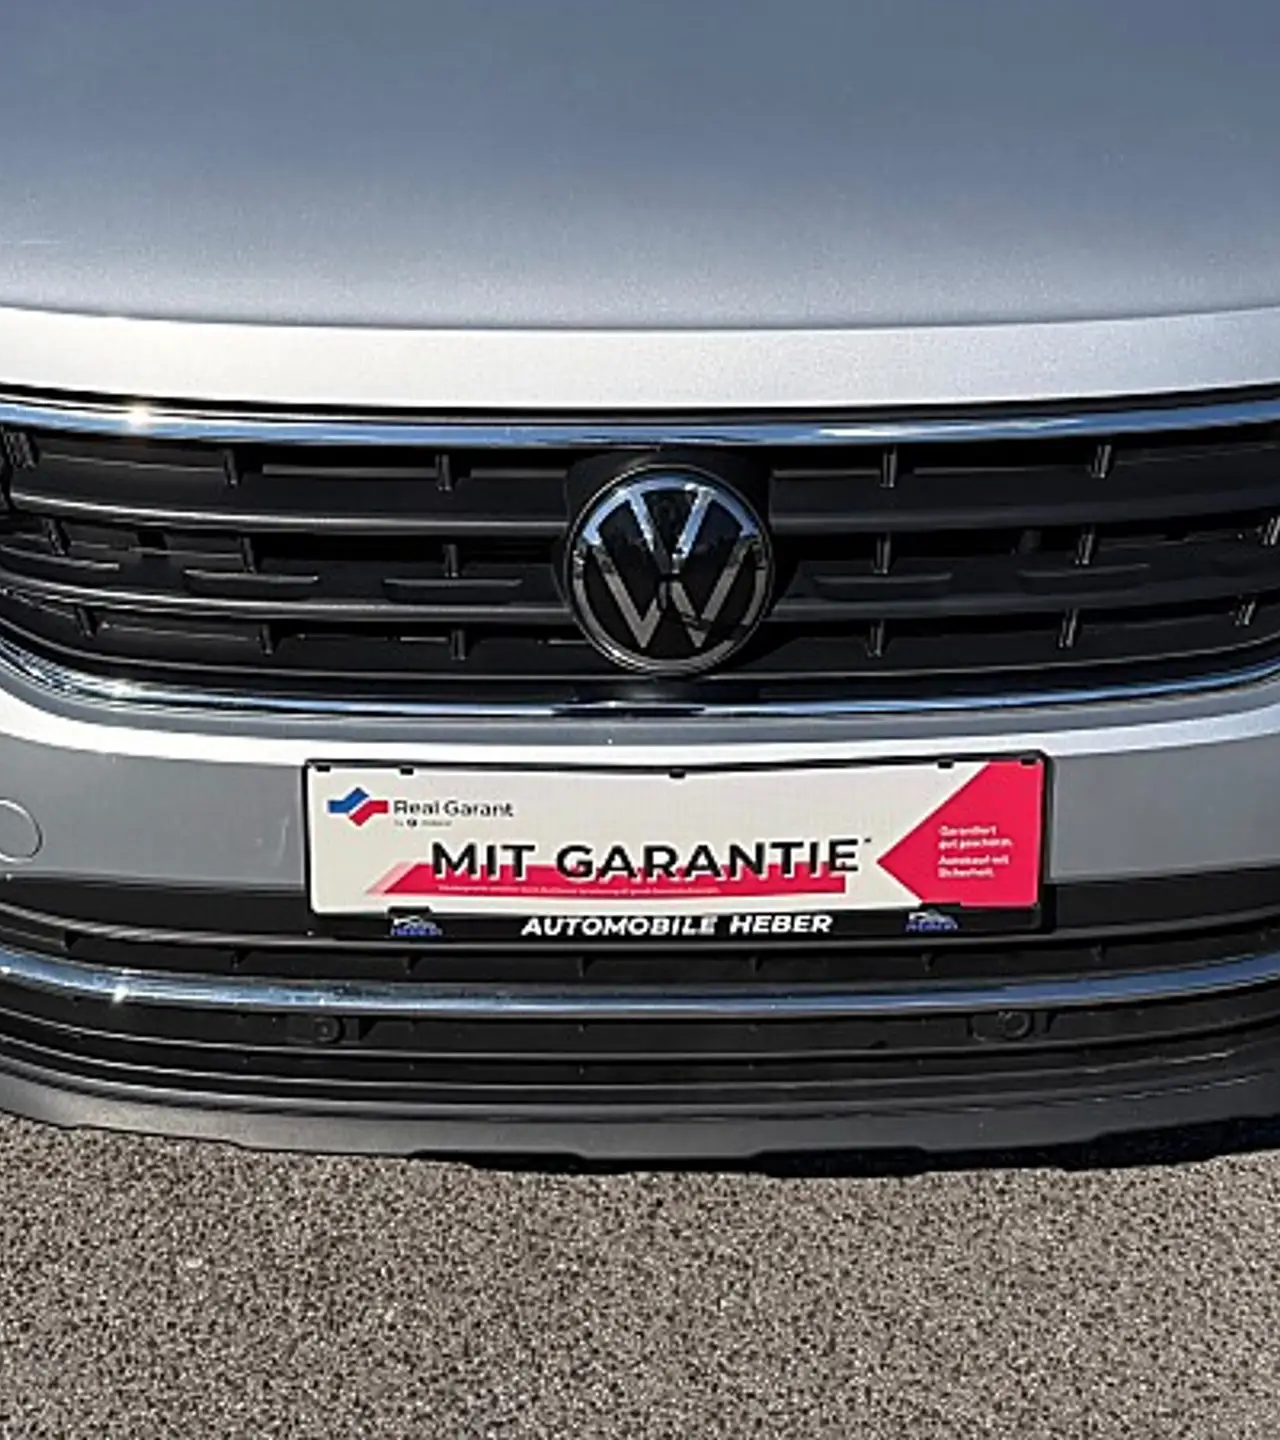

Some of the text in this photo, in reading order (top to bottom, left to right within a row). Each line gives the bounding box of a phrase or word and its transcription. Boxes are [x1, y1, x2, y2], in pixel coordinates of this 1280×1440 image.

[393, 799, 514, 817] Real Garant
[432, 843, 536, 879] MIT
[521, 915, 718, 936] AUTOMOBILE
[730, 914, 833, 933] HEBER
